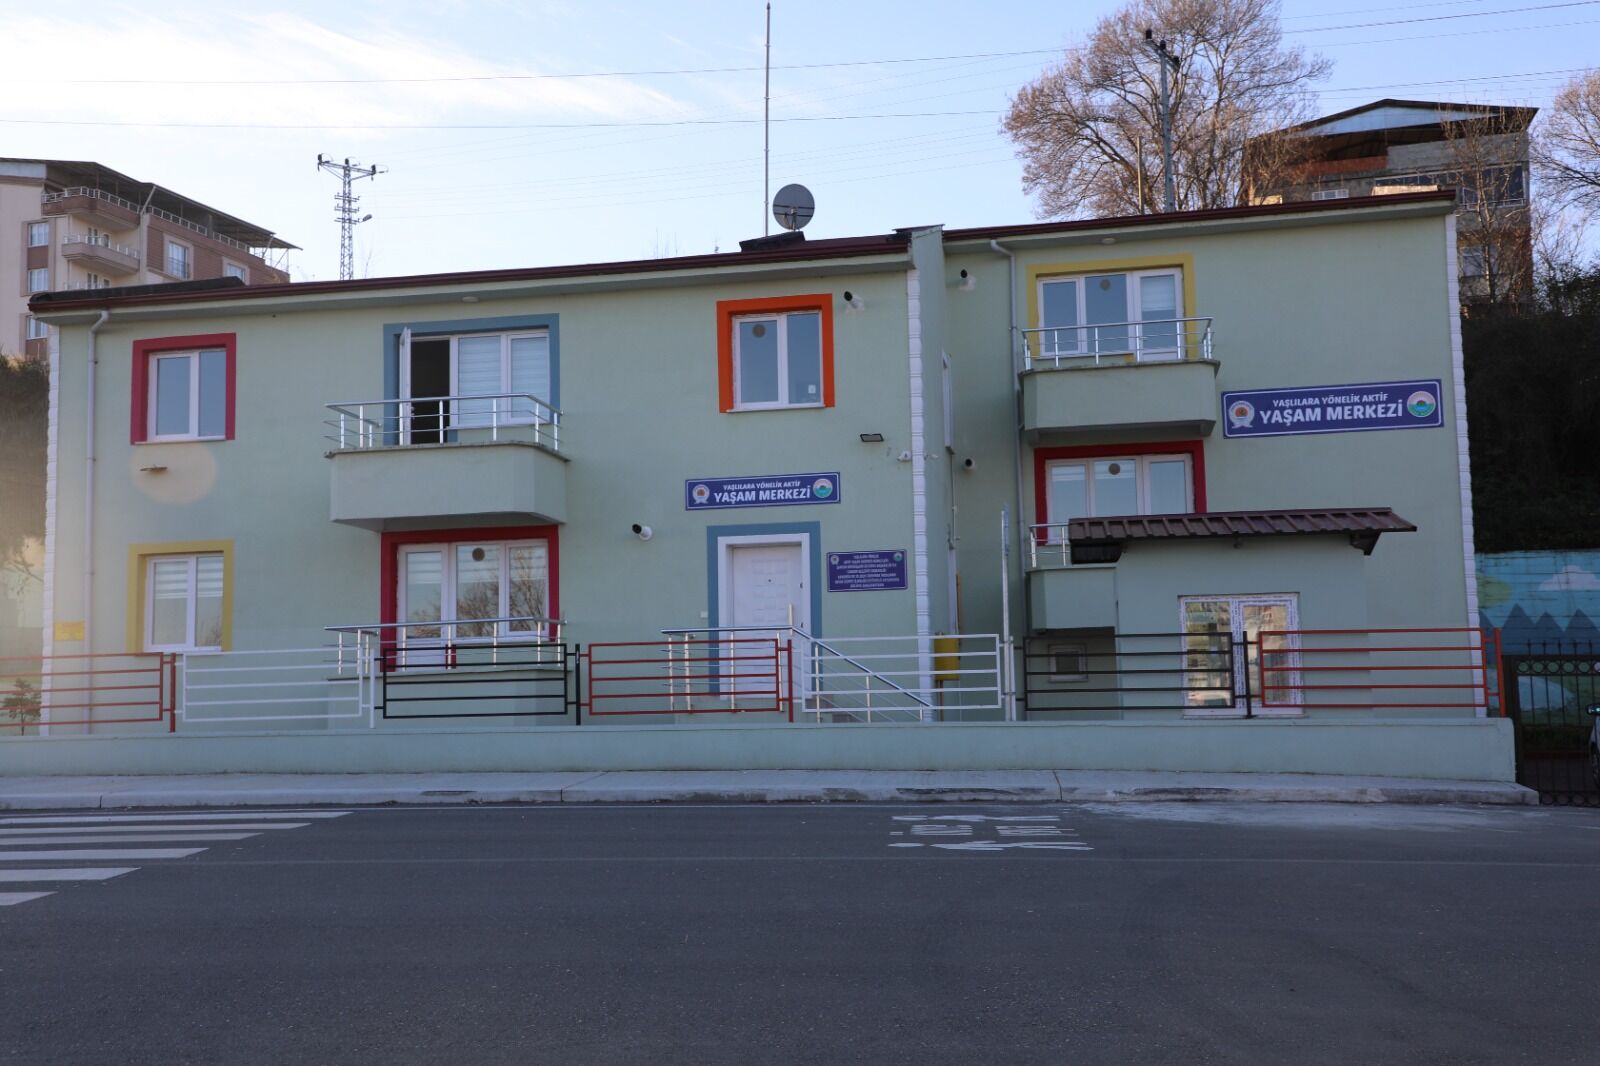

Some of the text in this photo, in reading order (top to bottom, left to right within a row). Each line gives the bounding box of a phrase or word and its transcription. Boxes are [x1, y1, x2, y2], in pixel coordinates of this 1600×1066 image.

[1272, 392, 1389, 408] YAŞLILARA YÖNELİK AKTİF
[1260, 400, 1402, 426] YAŞAM MERKEZİ
[714, 486, 810, 504] YAŞAM MERKEZİ
[723, 483, 755, 492] YAŞLILARA
[757, 481, 782, 489] YÖNELİK
